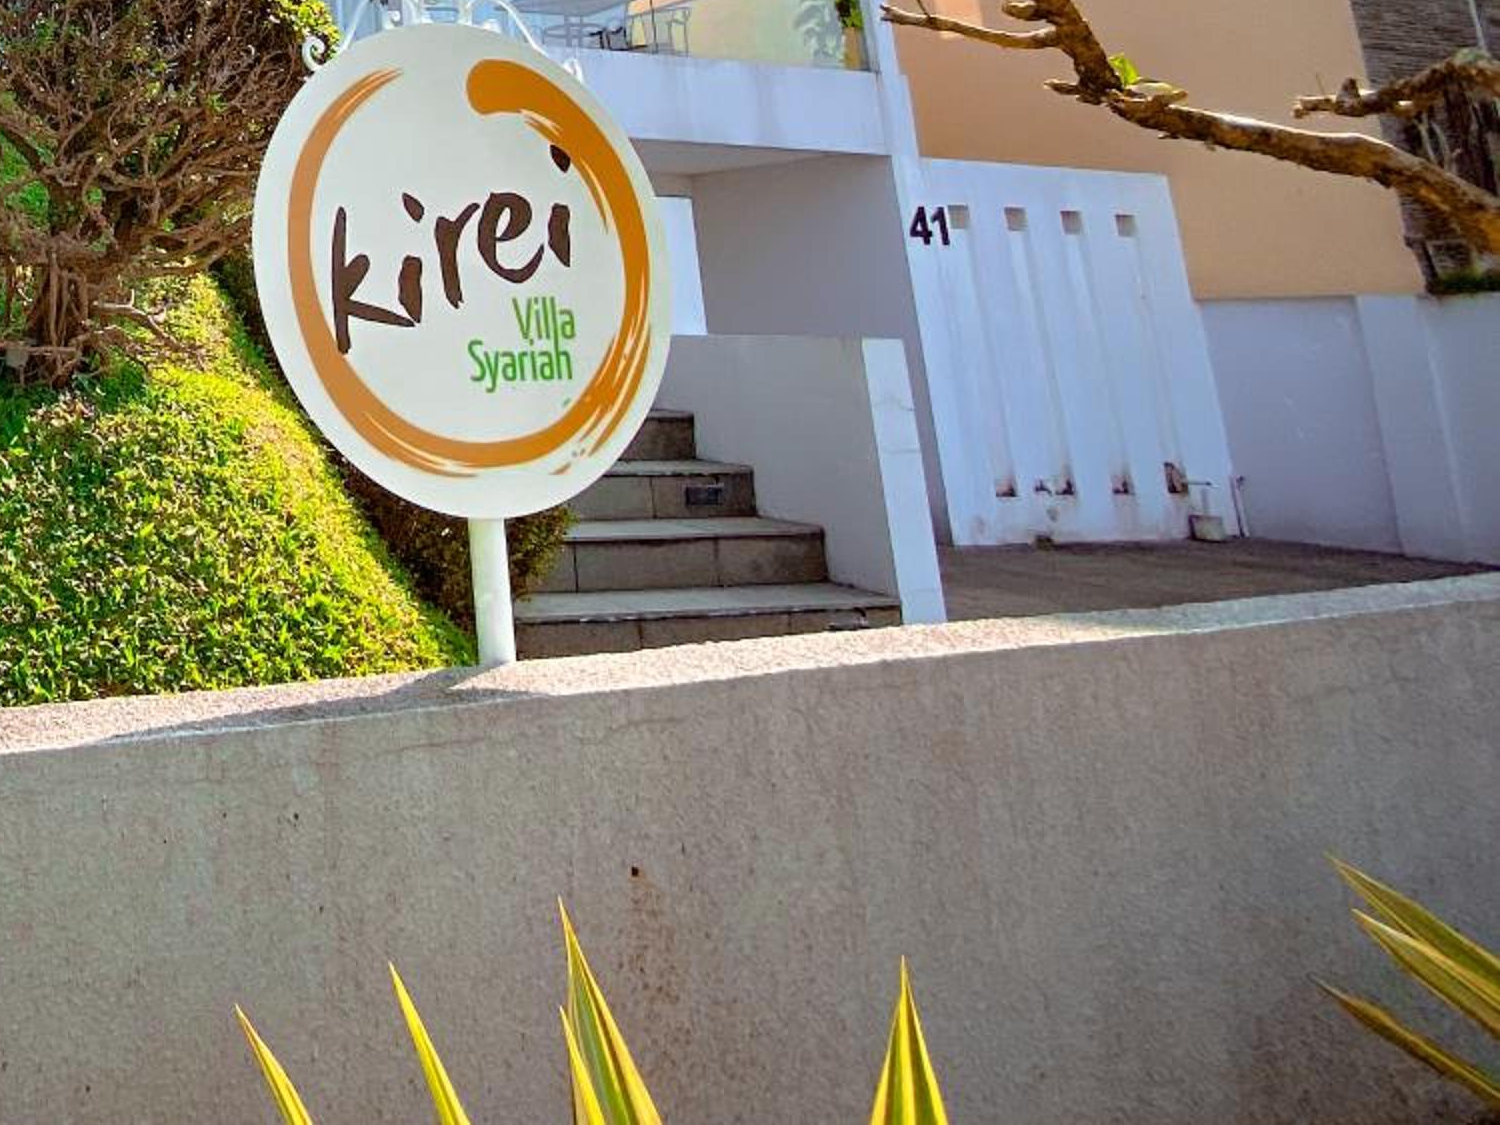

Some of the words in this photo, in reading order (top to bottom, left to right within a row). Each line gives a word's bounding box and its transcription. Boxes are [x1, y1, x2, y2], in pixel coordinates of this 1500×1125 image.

[331, 144, 572, 354] kirei
[909, 205, 951, 246] 41
[512, 296, 576, 341] Villa
[467, 338, 573, 393] Syariah
